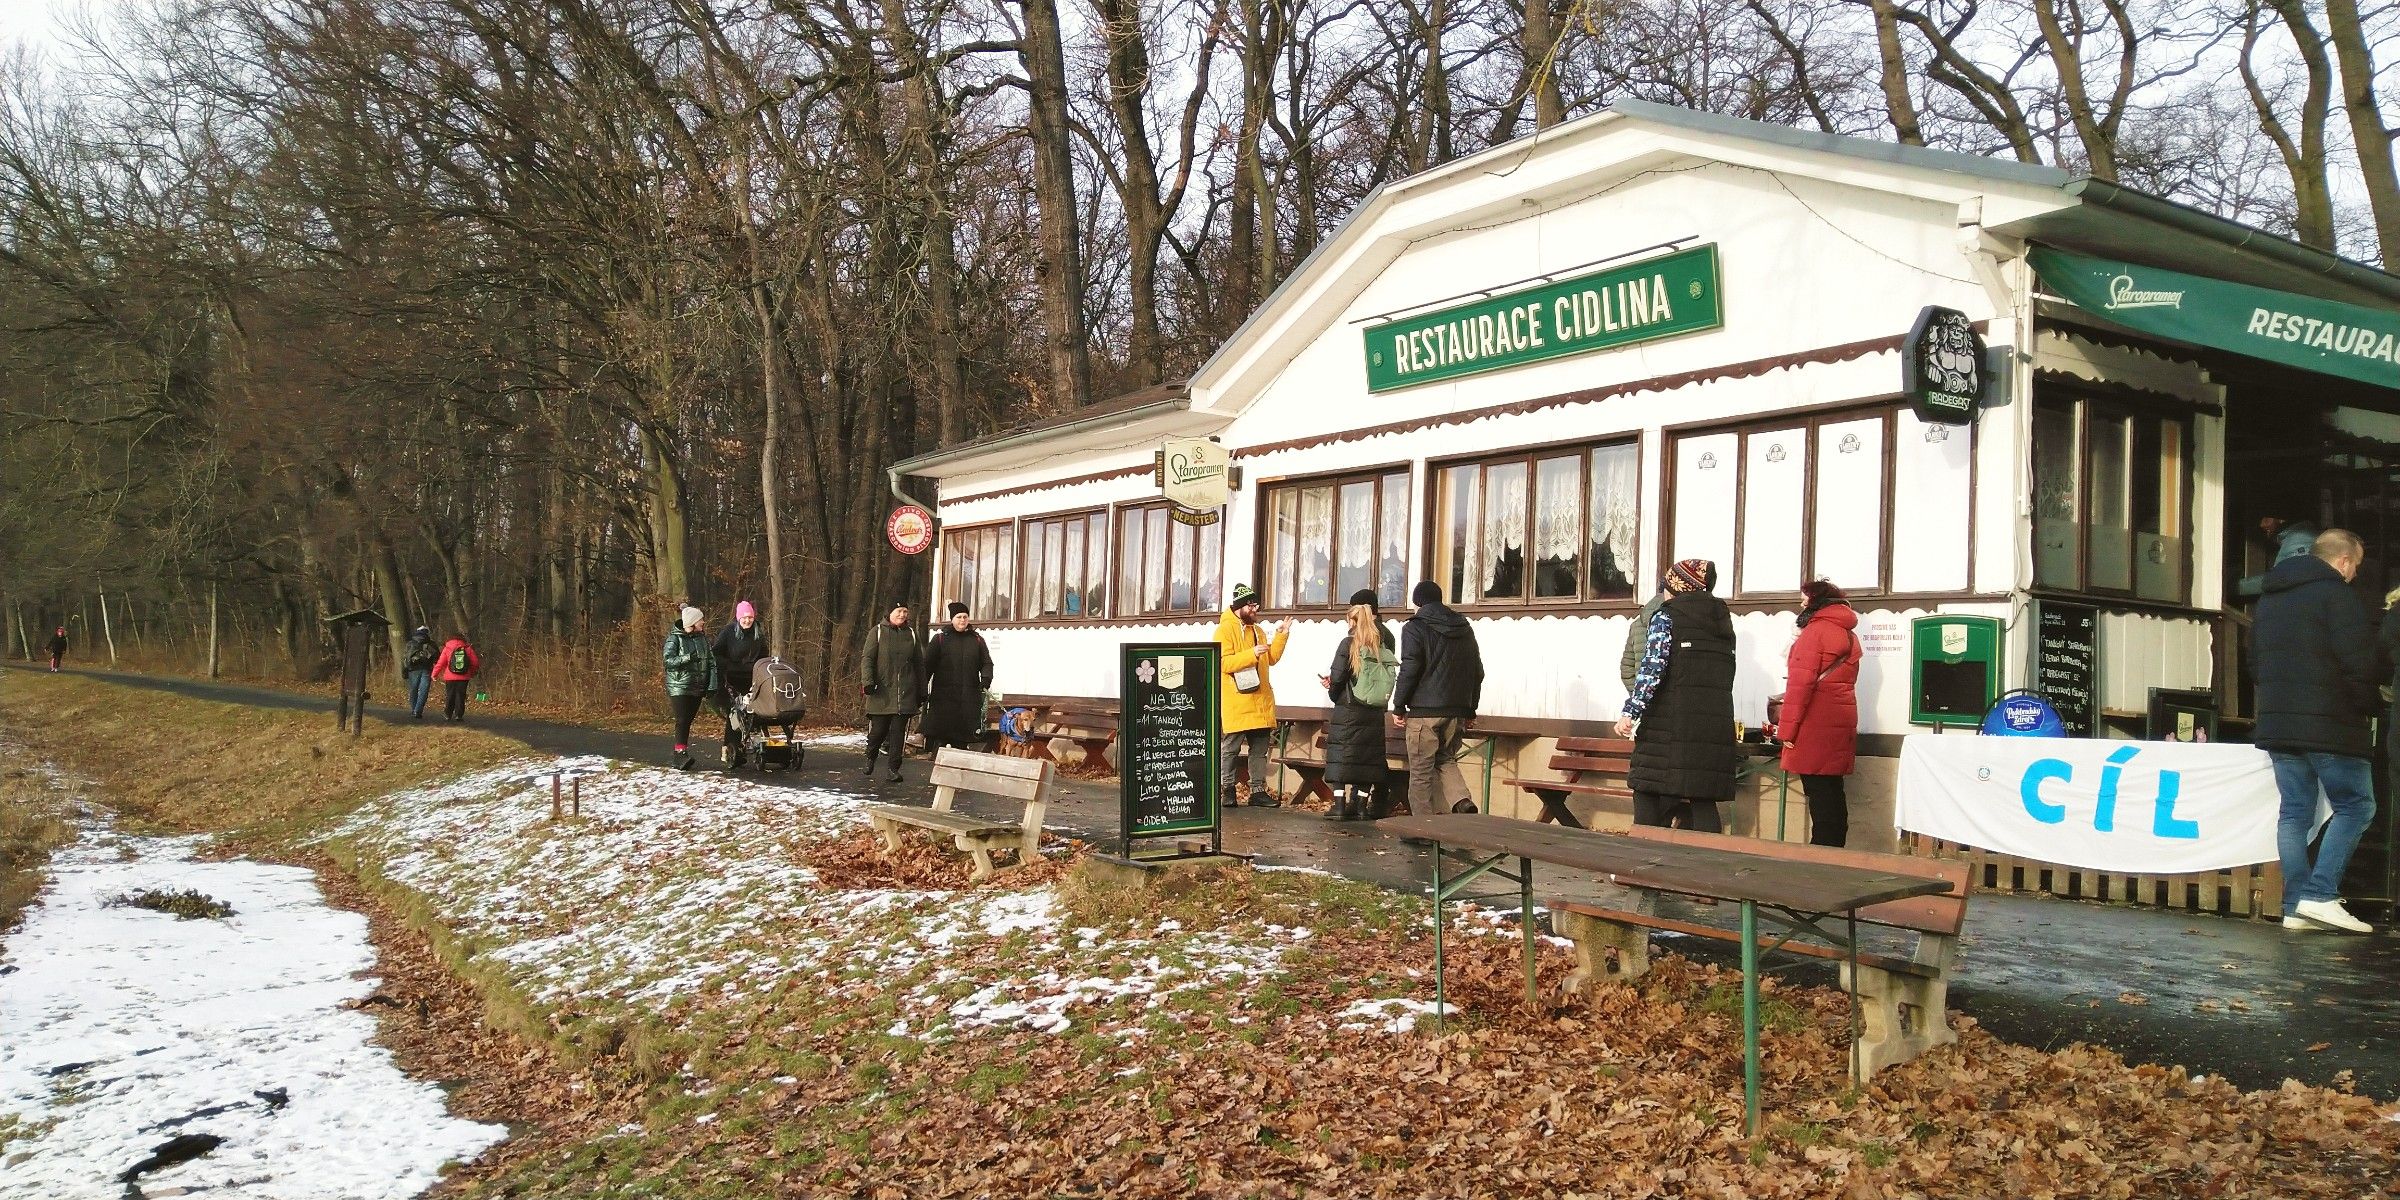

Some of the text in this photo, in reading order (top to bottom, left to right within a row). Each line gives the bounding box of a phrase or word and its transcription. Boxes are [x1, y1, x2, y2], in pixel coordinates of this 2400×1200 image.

[2104, 274, 2183, 310] Staropramen
[1394, 273, 1673, 376] RESTAURACE CIDLINA
[1931, 391, 1972, 411] RADEGAST
[1170, 453, 1224, 485] Staropramen
[1173, 509, 1216, 526] NEPASTER
[1150, 693, 1166, 705] NA
[1167, 780, 1194, 791] KOFOLA
[2019, 744, 2200, 840] CÍL
[1167, 795, 1195, 806] MALINA
